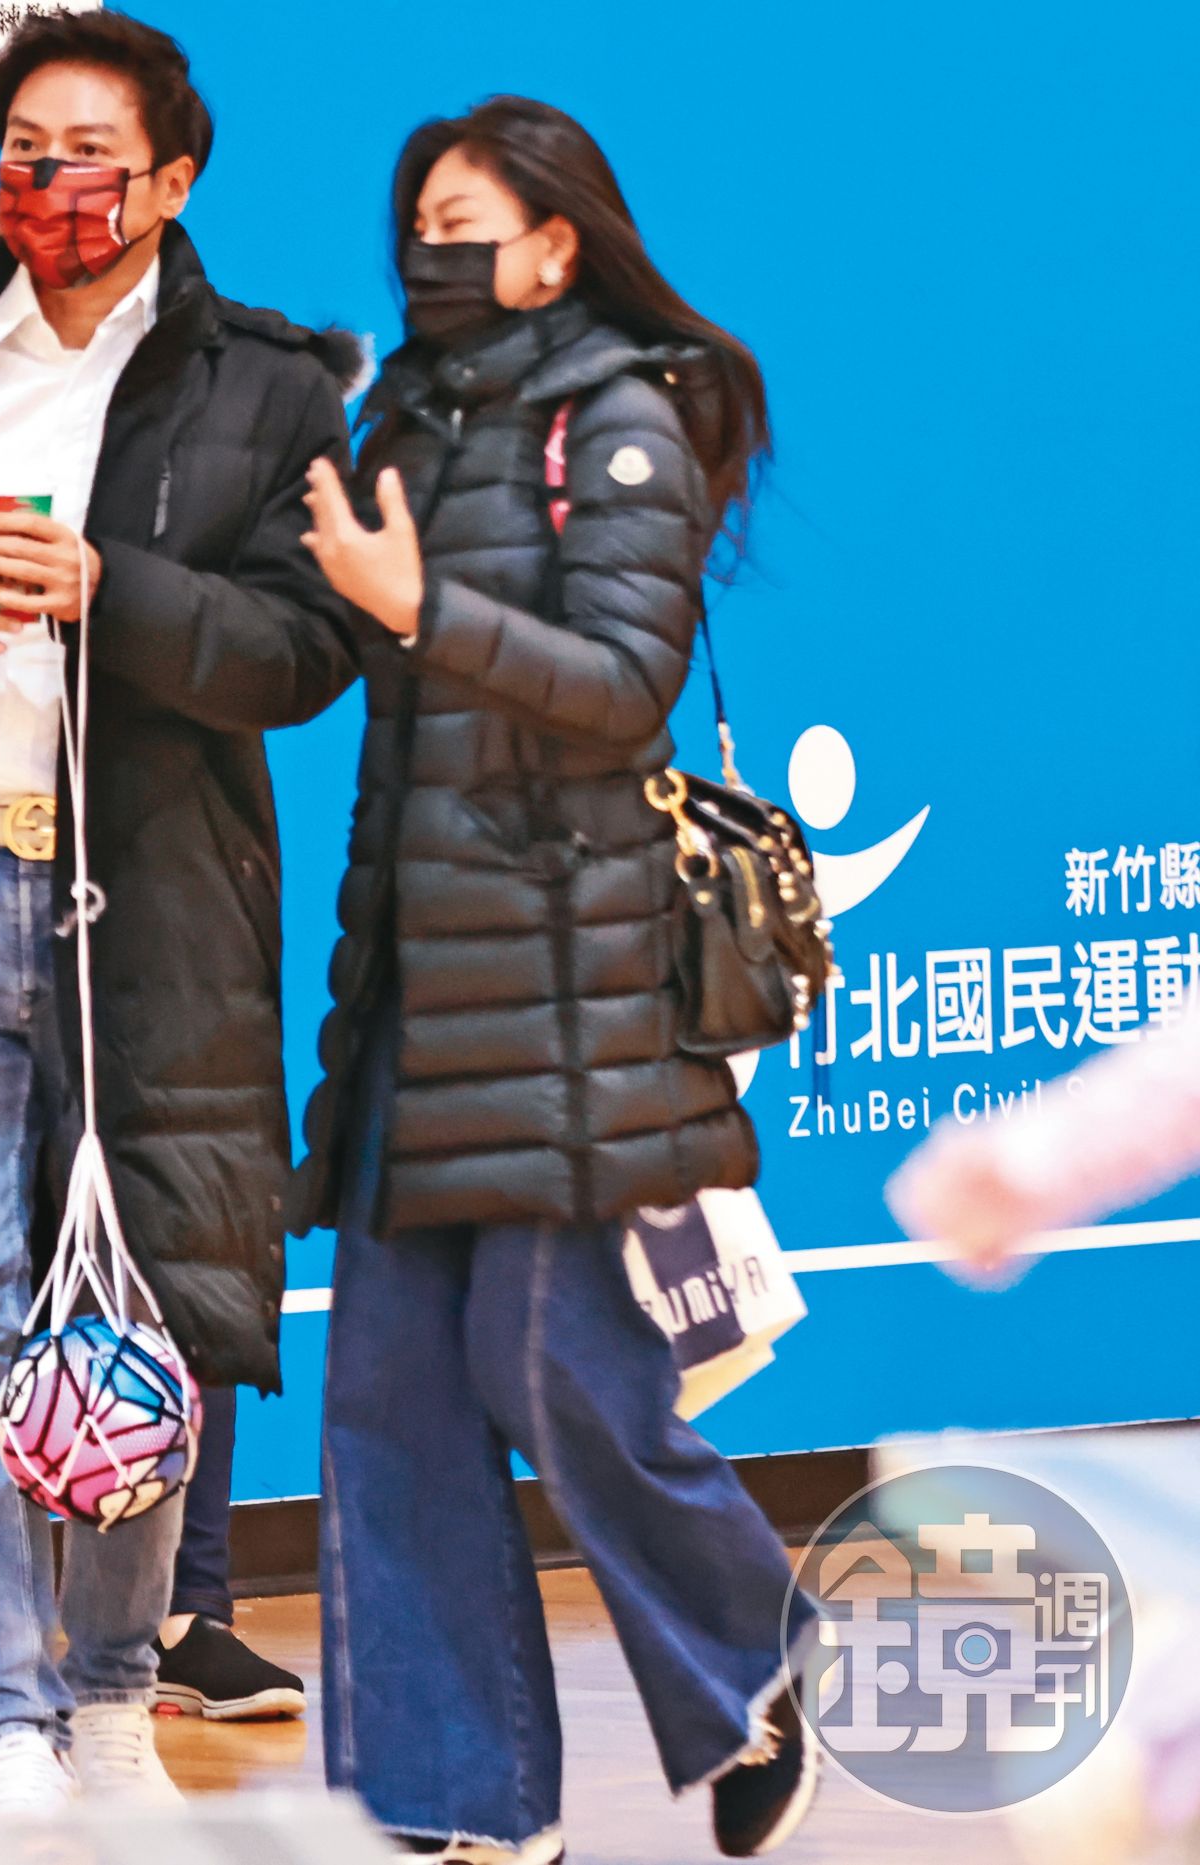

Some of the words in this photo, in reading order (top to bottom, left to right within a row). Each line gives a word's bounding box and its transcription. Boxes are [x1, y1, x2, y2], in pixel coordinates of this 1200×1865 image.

[1063, 841, 1200, 917] 新竹縣
[788, 1086, 931, 1138] ZhuBei
